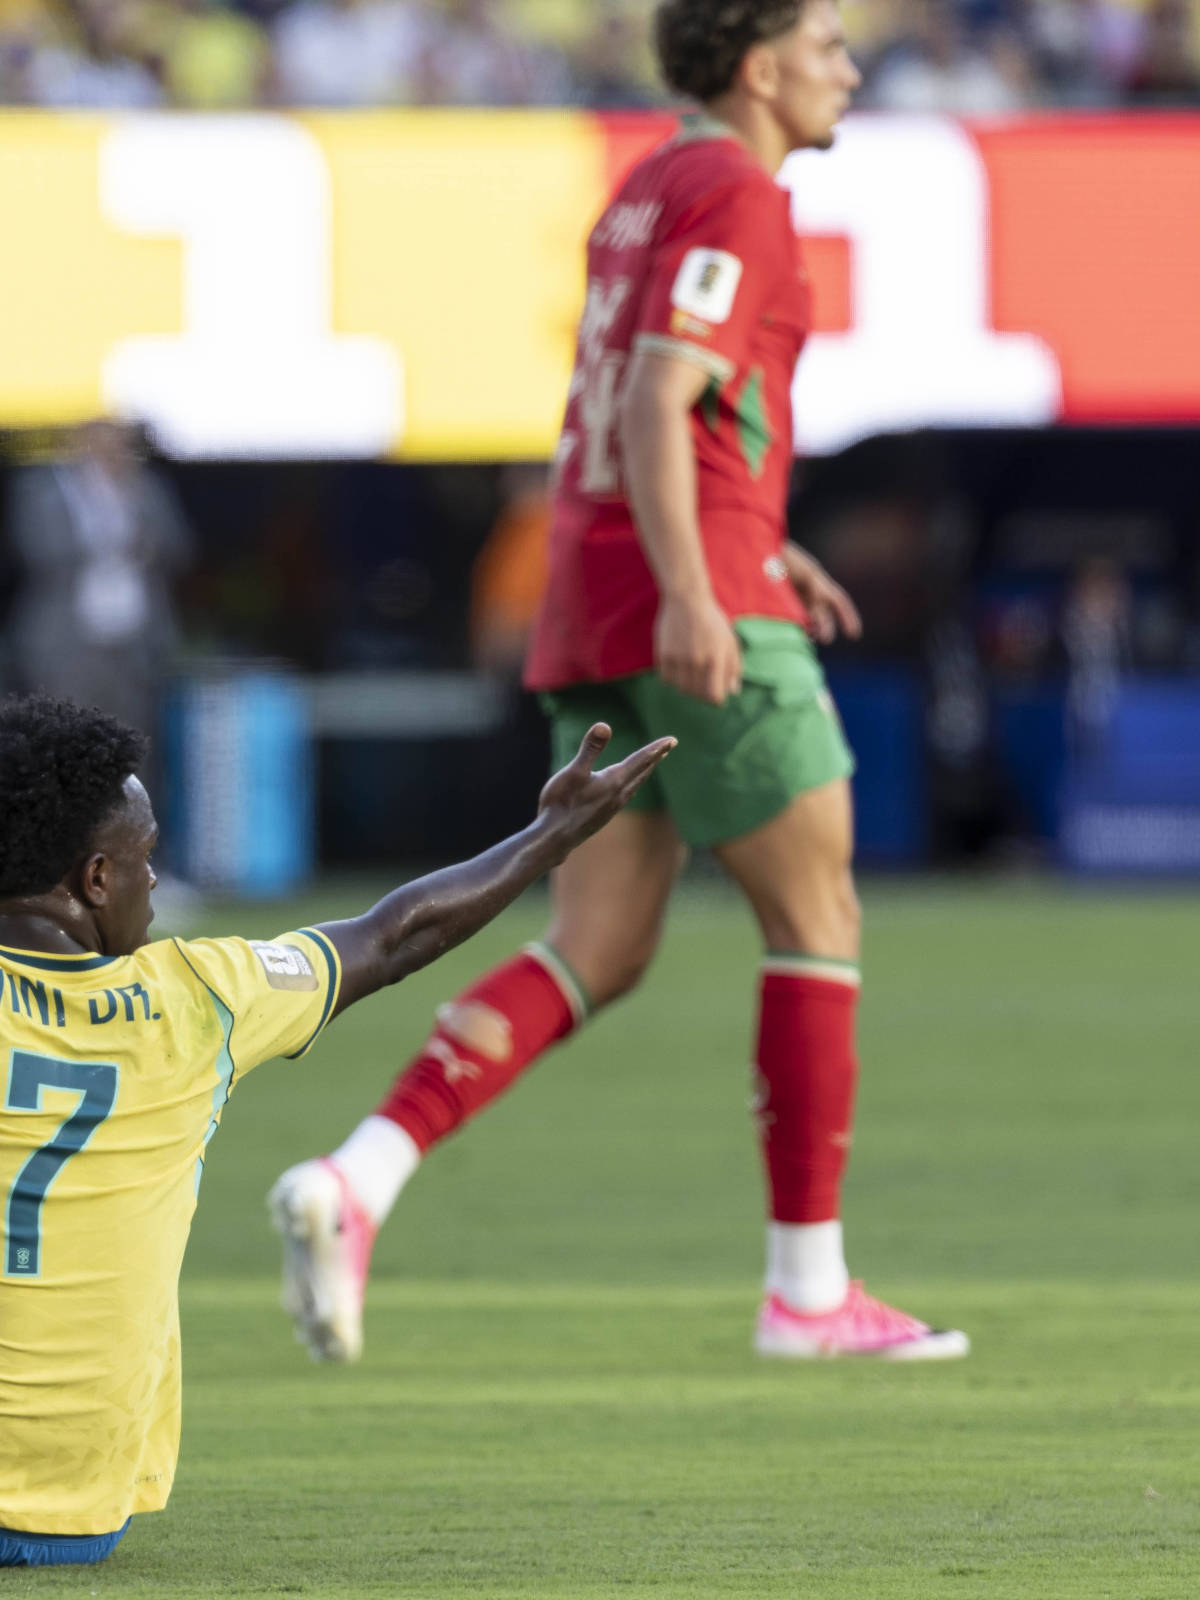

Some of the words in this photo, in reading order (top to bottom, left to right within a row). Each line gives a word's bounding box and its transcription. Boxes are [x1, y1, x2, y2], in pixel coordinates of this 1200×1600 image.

[100, 112, 405, 462] 1
[785, 112, 1062, 456] 1
[3, 1046, 121, 1279] 7
